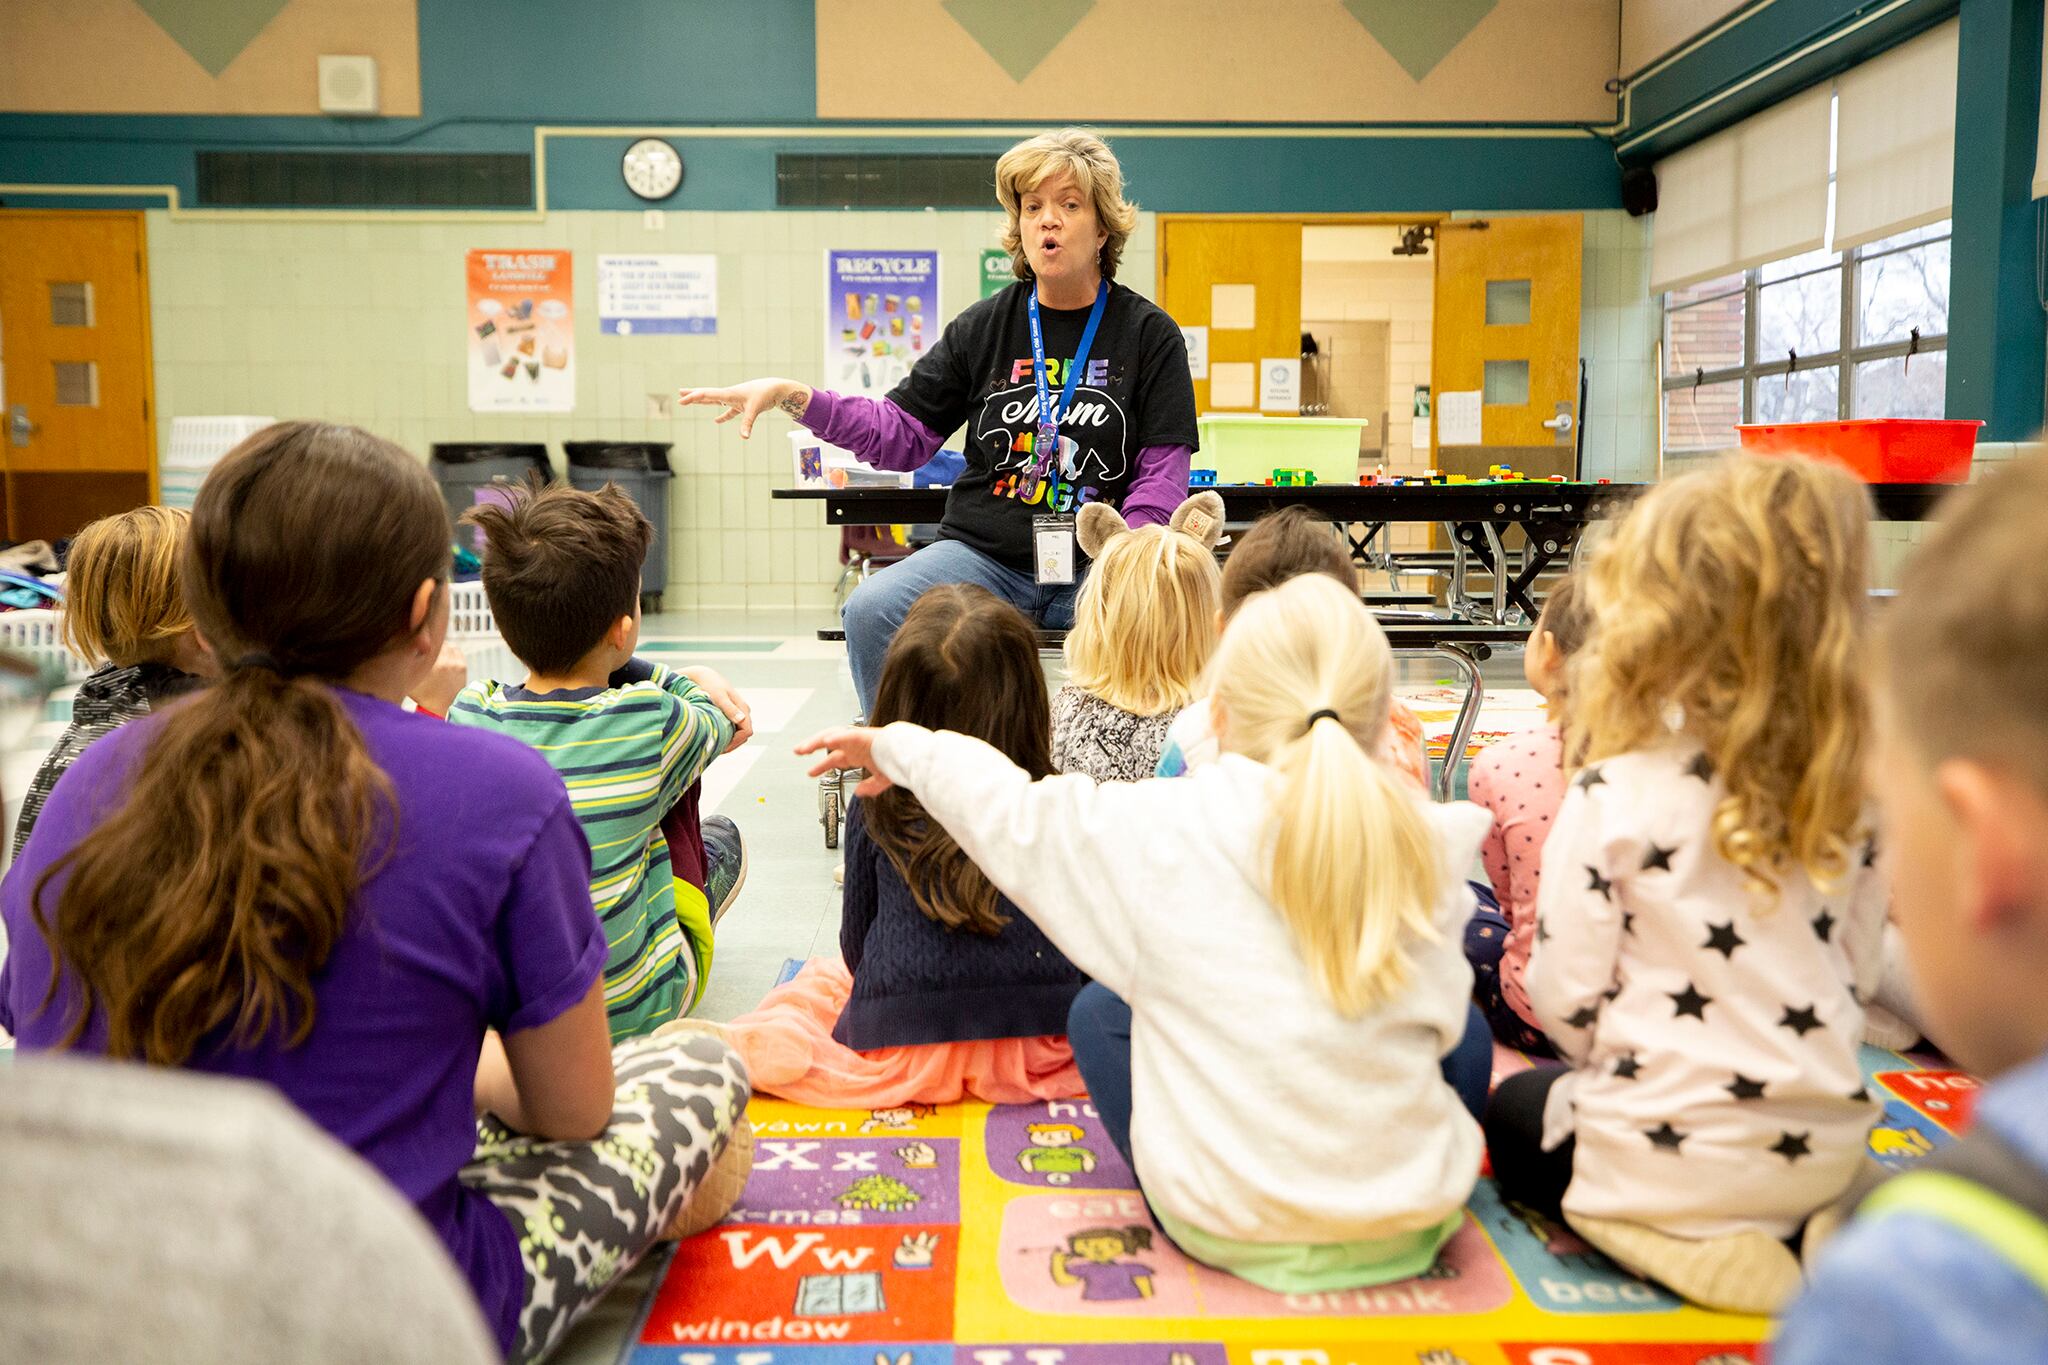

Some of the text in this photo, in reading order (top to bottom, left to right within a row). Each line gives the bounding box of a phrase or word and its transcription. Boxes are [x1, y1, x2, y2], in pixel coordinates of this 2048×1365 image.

[482, 254, 555, 271] TRASH
[836, 257, 932, 274] RECYCLE
[1009, 358, 1109, 387] FREE
[1001, 394, 1110, 427] Mom
[993, 474, 1099, 512] HUGS
[1049, 1199, 1141, 1218] eat
[719, 1230, 874, 1270] Ww
[672, 1316, 850, 1340] window
